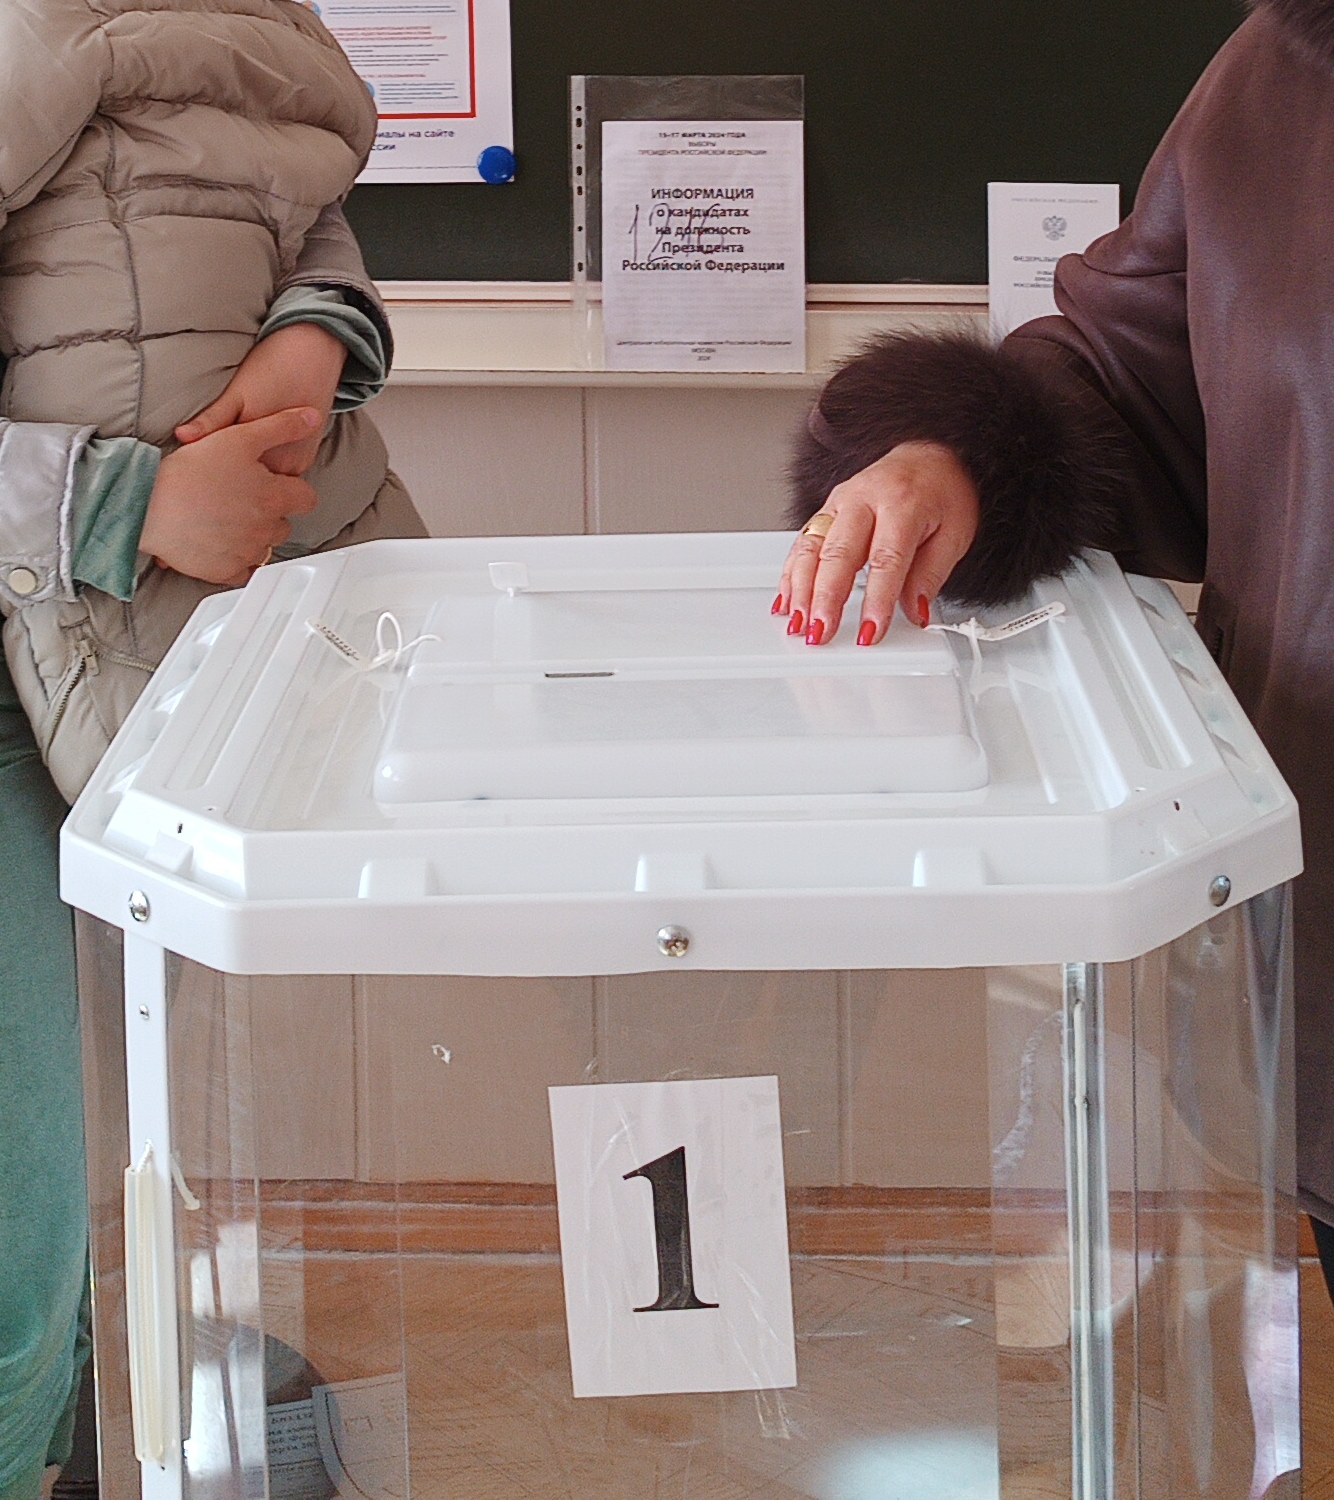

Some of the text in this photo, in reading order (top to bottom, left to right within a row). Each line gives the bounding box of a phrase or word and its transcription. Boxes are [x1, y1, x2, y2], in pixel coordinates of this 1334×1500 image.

[651, 188, 754, 201] ИНФОРМАЦИЯ
[622, 259, 785, 273] Российской Федерации
[622, 1145, 721, 1314] 1
